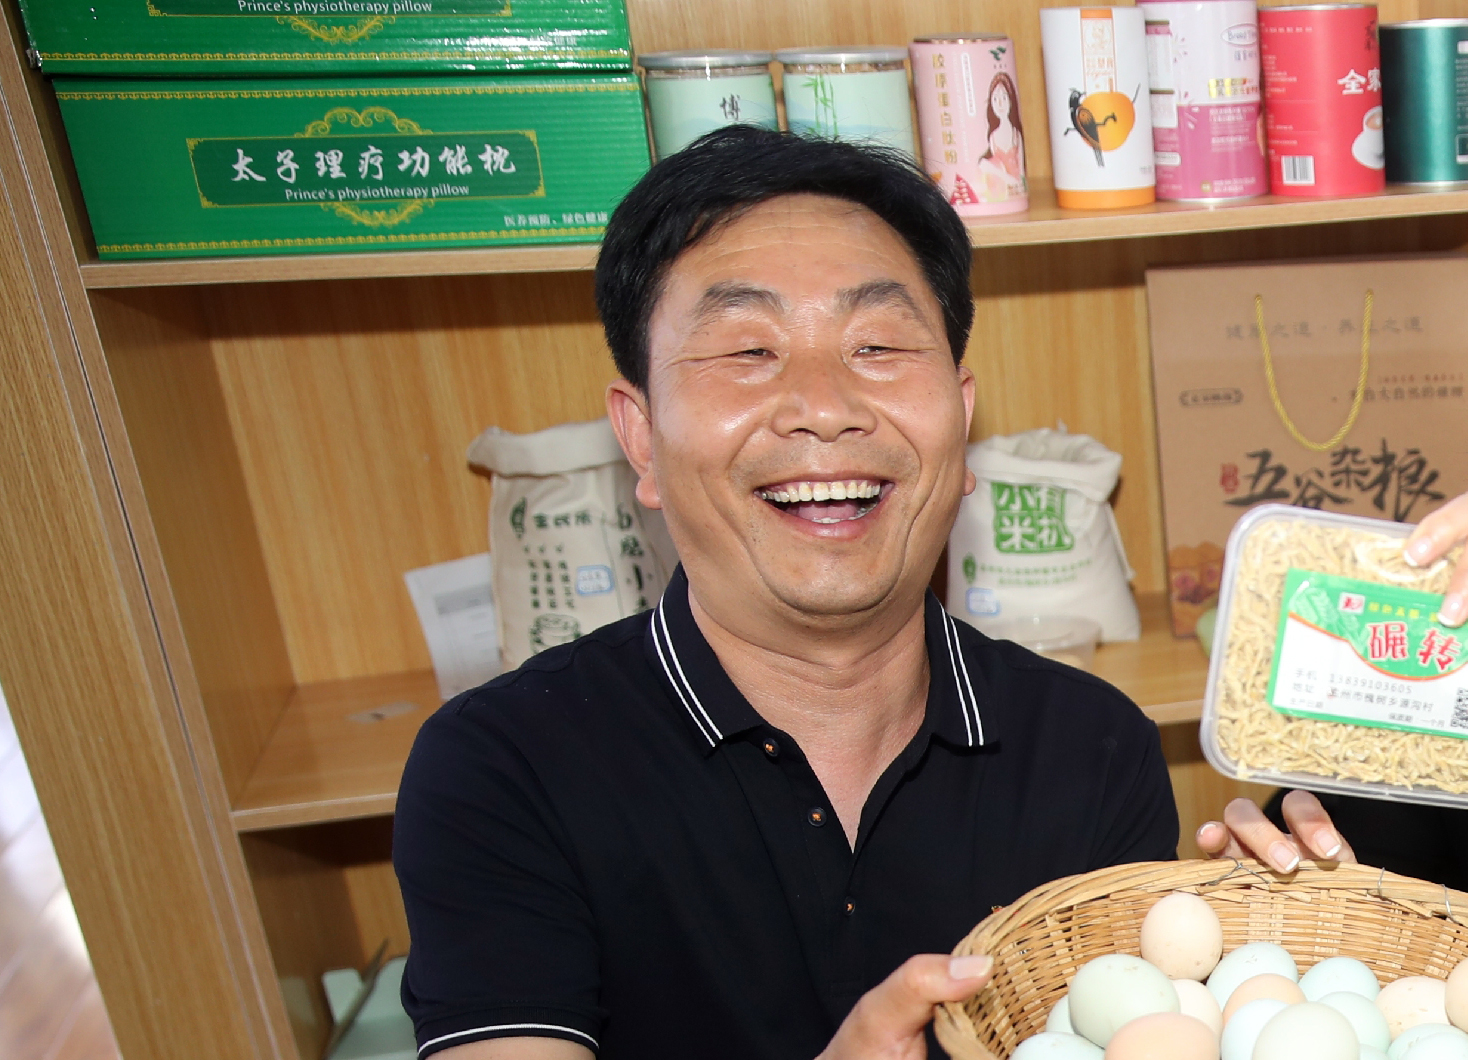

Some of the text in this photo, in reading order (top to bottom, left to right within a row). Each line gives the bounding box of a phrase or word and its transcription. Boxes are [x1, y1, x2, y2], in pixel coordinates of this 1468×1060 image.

[238, 0, 433, 14] Prince's physiotherapy pillow
[231, 144, 516, 183] 太子理疗功能枕
[285, 183, 469, 201] Prince's physiotherapy pillow
[1225, 437, 1445, 522] 五谷杂粮
[1368, 621, 1462, 671] 碾转
